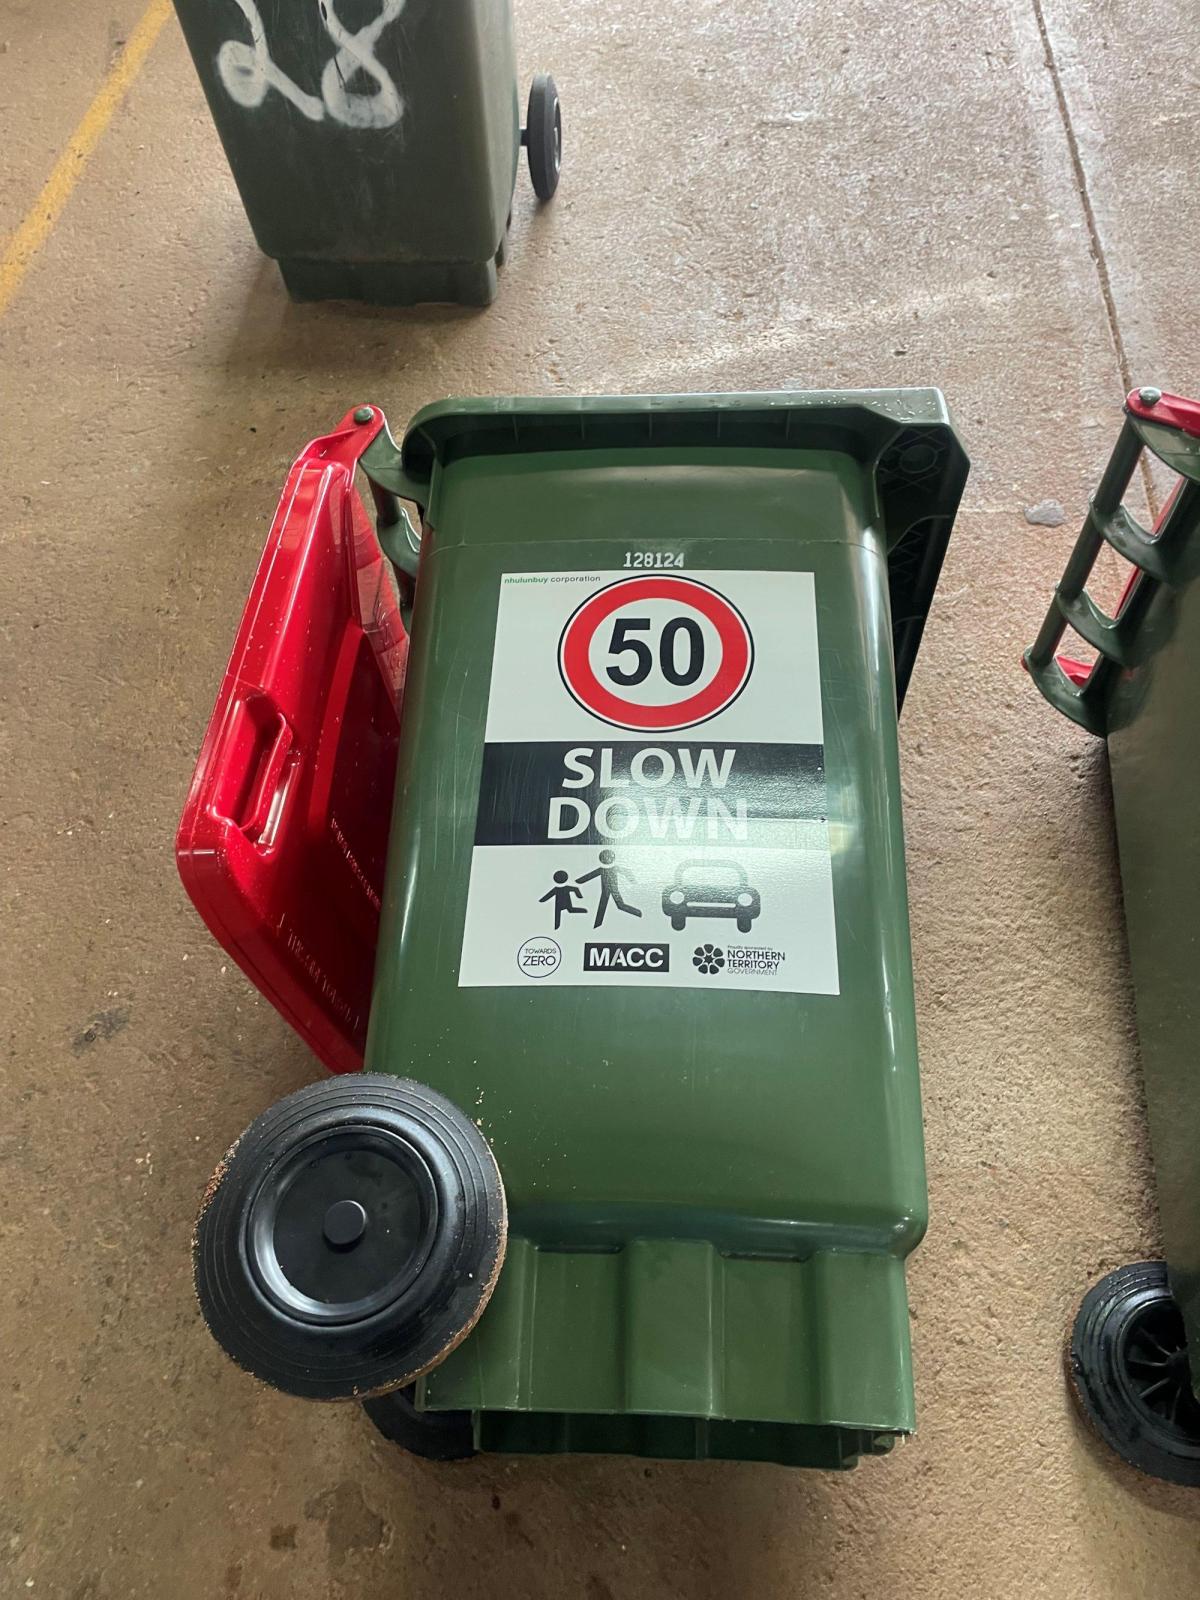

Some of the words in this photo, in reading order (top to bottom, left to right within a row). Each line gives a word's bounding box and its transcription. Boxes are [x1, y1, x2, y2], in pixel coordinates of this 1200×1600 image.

[622, 552, 685, 568] 128124
[504, 575, 548, 584] nhulunbuy
[550, 575, 601, 584] corporation
[605, 617, 705, 686] 50
[562, 747, 737, 789] SLOW
[547, 796, 750, 840] DOWN
[522, 955, 556, 967] ZERO
[588, 948, 664, 968] MACC
[727, 949, 786, 961] NORTHERN
[727, 959, 780, 970] TERRITORY
[727, 968, 778, 976] GOVERNMENT
